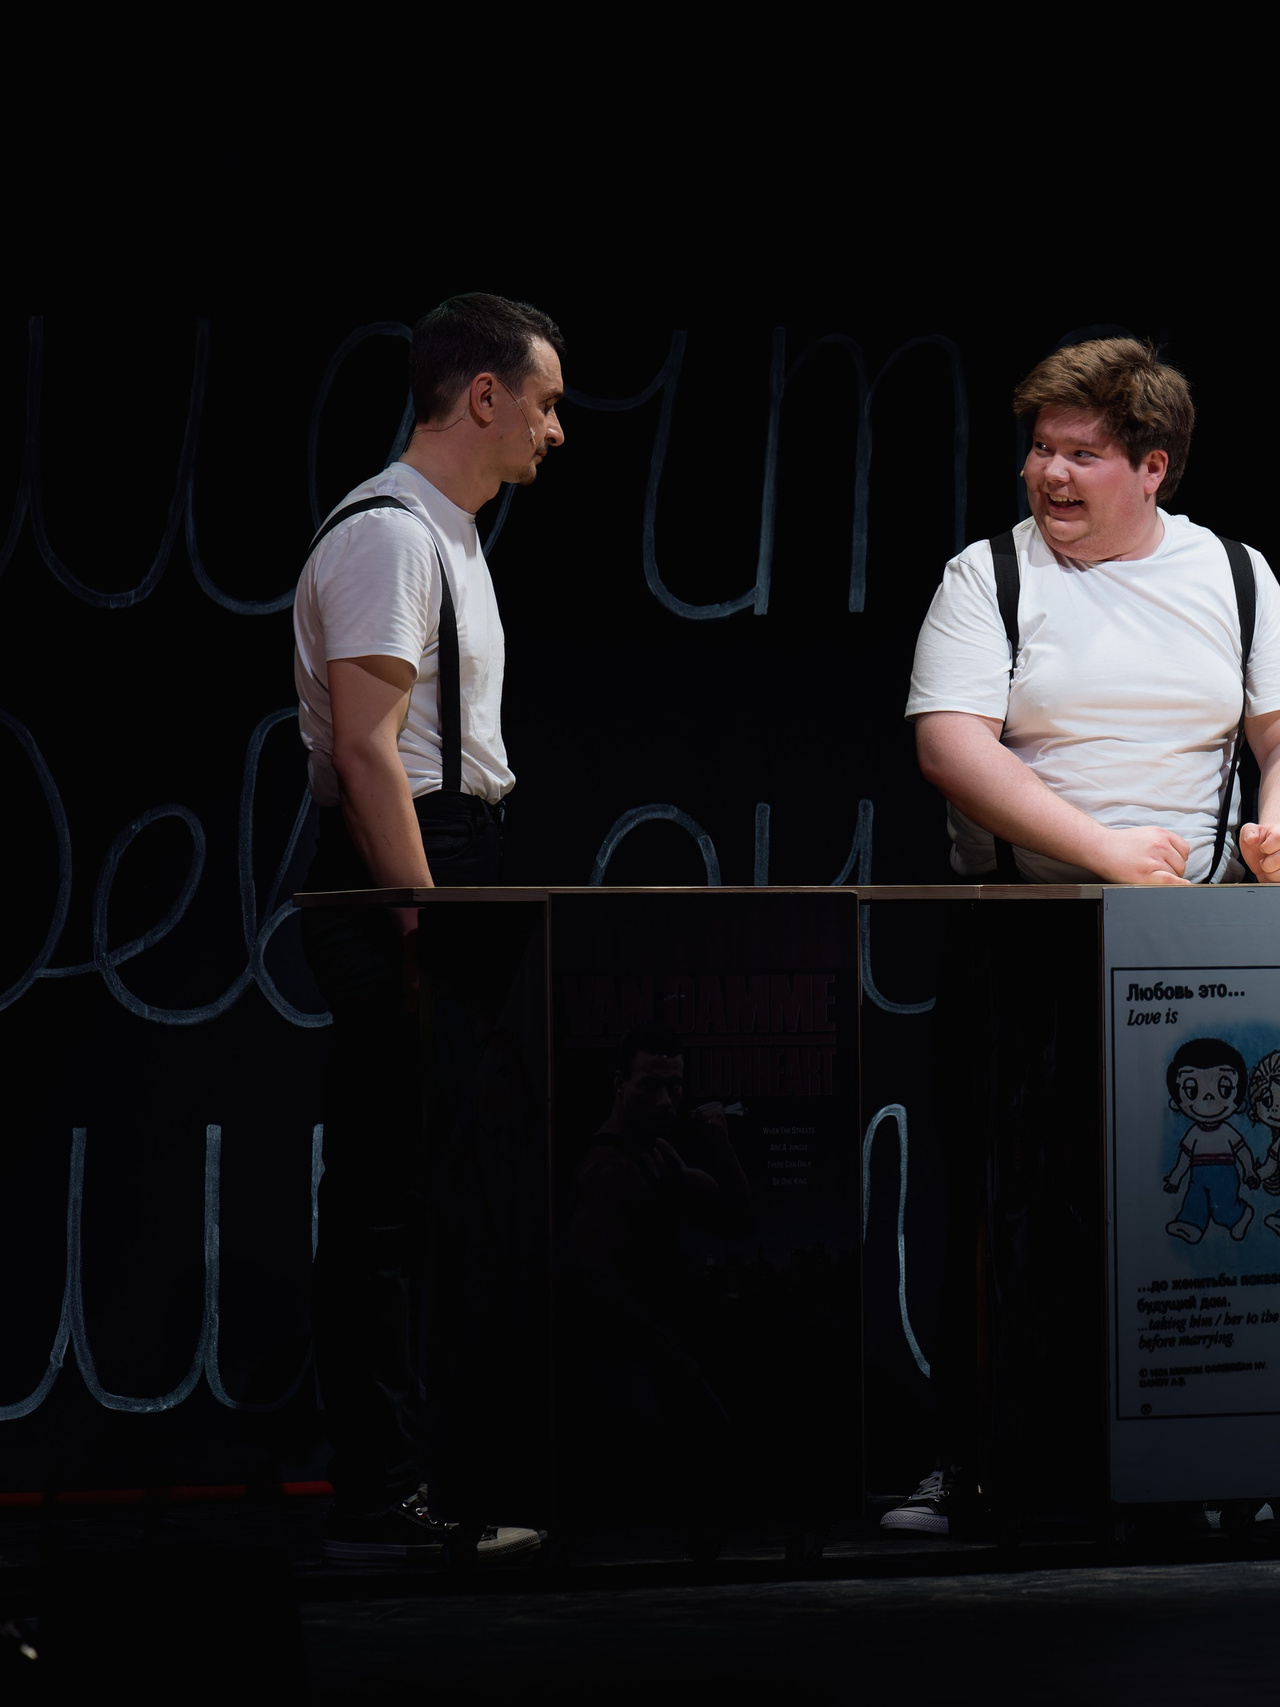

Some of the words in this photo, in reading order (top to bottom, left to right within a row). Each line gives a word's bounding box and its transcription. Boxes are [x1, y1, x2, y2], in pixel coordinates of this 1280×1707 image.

[1126, 981, 1194, 1002] Любовь
[1198, 983, 1246, 999] это...
[562, 974, 655, 1035] VAN
[664, 973, 837, 1034] DAMME
[1127, 1008, 1161, 1026] Love
[1165, 1007, 1179, 1025] is
[688, 1047, 837, 1097] LIONHEART
[1171, 1272, 1238, 1291] женитьбы
[1137, 1294, 1197, 1315] будущий
[1246, 1312, 1259, 1325] to
[1261, 1308, 1280, 1324] the
[1138, 1333, 1177, 1352] before
